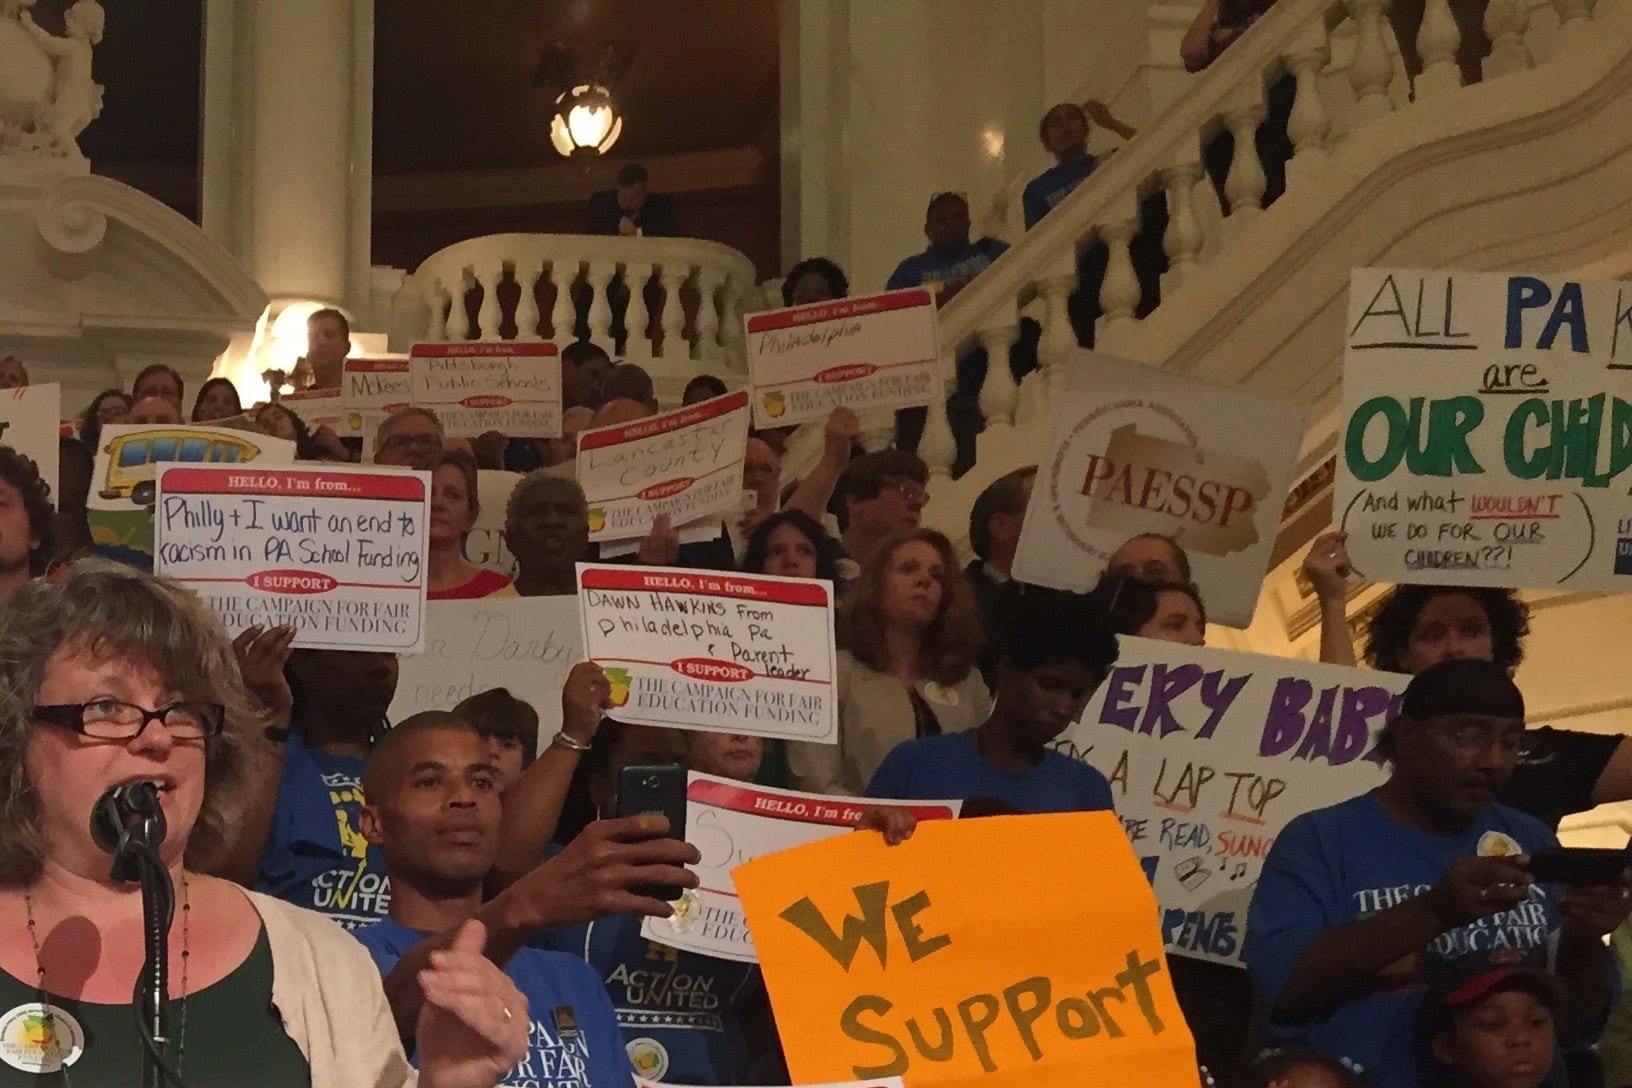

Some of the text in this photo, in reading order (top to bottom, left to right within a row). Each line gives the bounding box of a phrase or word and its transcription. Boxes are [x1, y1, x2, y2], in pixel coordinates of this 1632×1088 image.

[1350, 274, 1589, 353] ALL PA
[1482, 362, 1549, 387] are
[1345, 395, 1485, 481] OUR
[228, 476, 361, 492] HELLO, I'm from...
[1078, 454, 1253, 528] PAESSP
[1408, 490, 1465, 513] what
[164, 496, 224, 542] Philly
[229, 509, 241, 524] +
[243, 499, 265, 530] I
[272, 508, 322, 533] want
[328, 515, 352, 533] an
[357, 510, 392, 533] end
[1372, 521, 1545, 541] WE DO FOR OUR
[159, 536, 419, 582] racism in PA School Funding
[264, 576, 331, 589] SUPPORT
[643, 576, 767, 596] HELLO, I'm from...
[587, 590, 640, 609] DAWN
[651, 592, 726, 616] HAWKINS
[598, 616, 733, 641] Philadelphia
[732, 642, 794, 664] Parent
[686, 664, 748, 679] SUPPORT
[1153, 758, 1215, 808] LAP
[1224, 772, 1287, 816] TOP
[778, 868, 952, 973] WE
